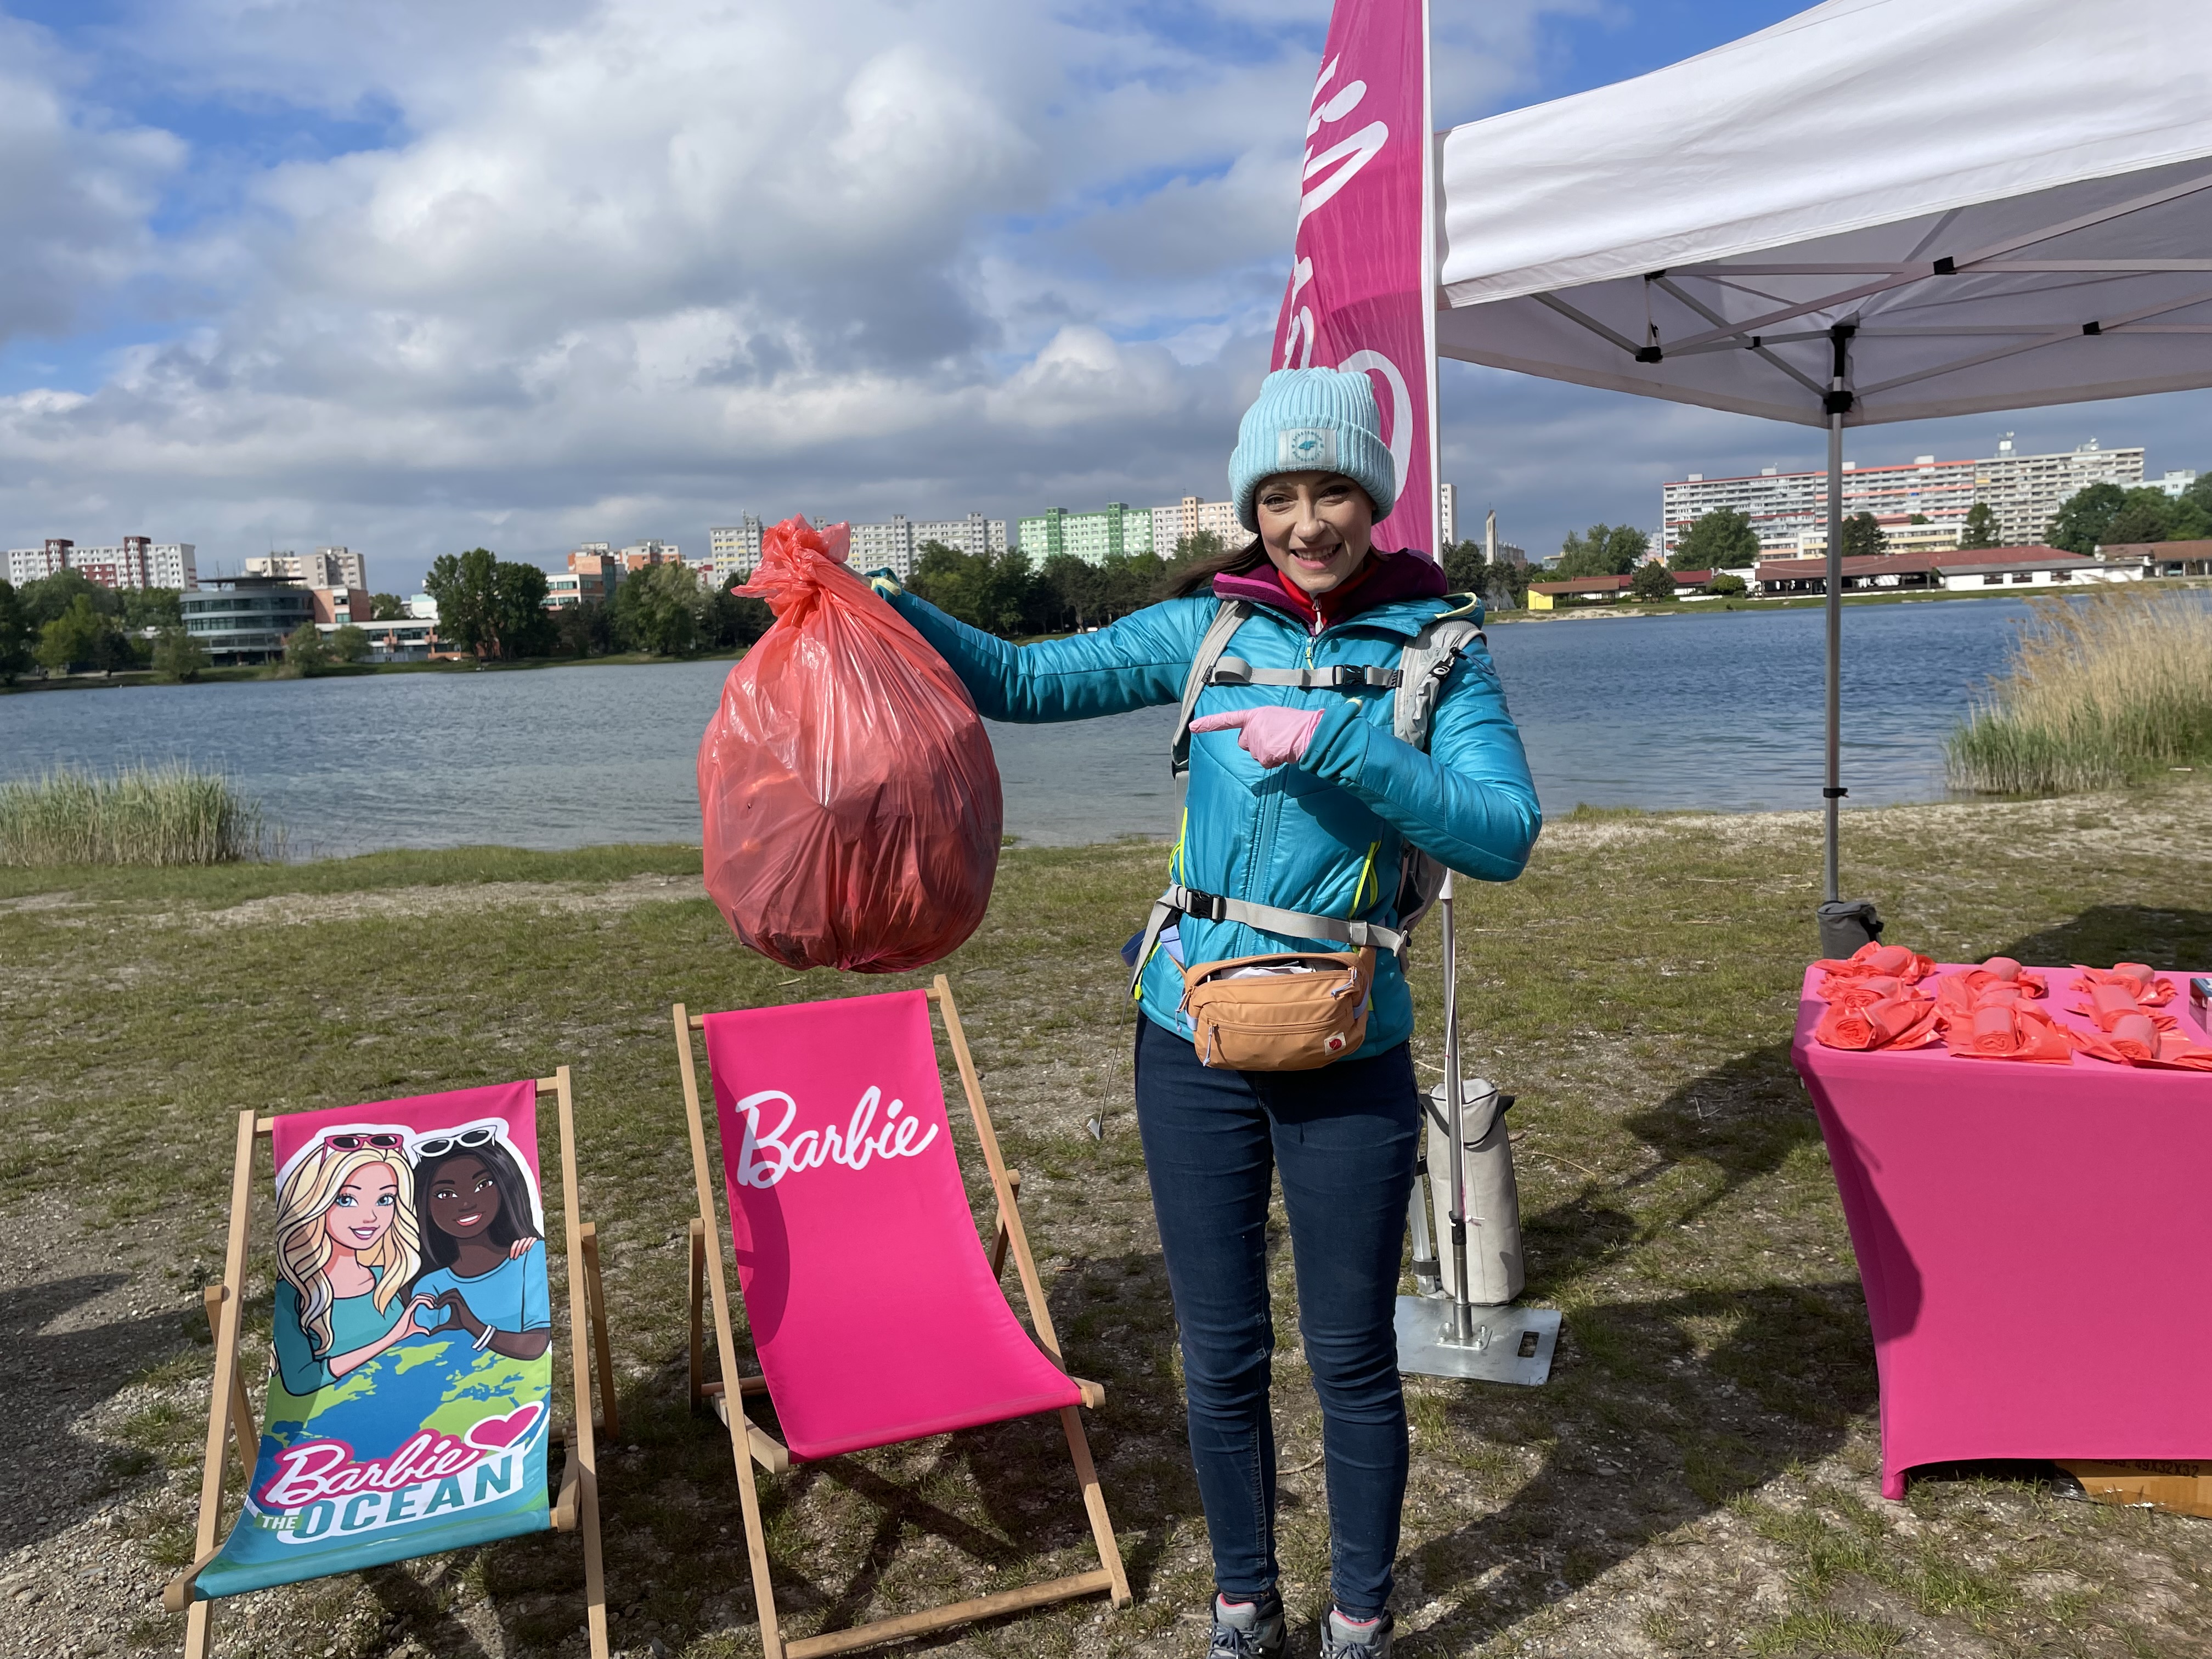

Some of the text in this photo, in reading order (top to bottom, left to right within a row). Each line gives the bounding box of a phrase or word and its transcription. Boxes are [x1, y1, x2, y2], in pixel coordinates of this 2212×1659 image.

[1298, 440, 1316, 450] 4F
[735, 1085, 939, 1189] Barbie
[261, 1457, 514, 1539] THE OCEAN
[266, 1433, 480, 1505] Barbie
